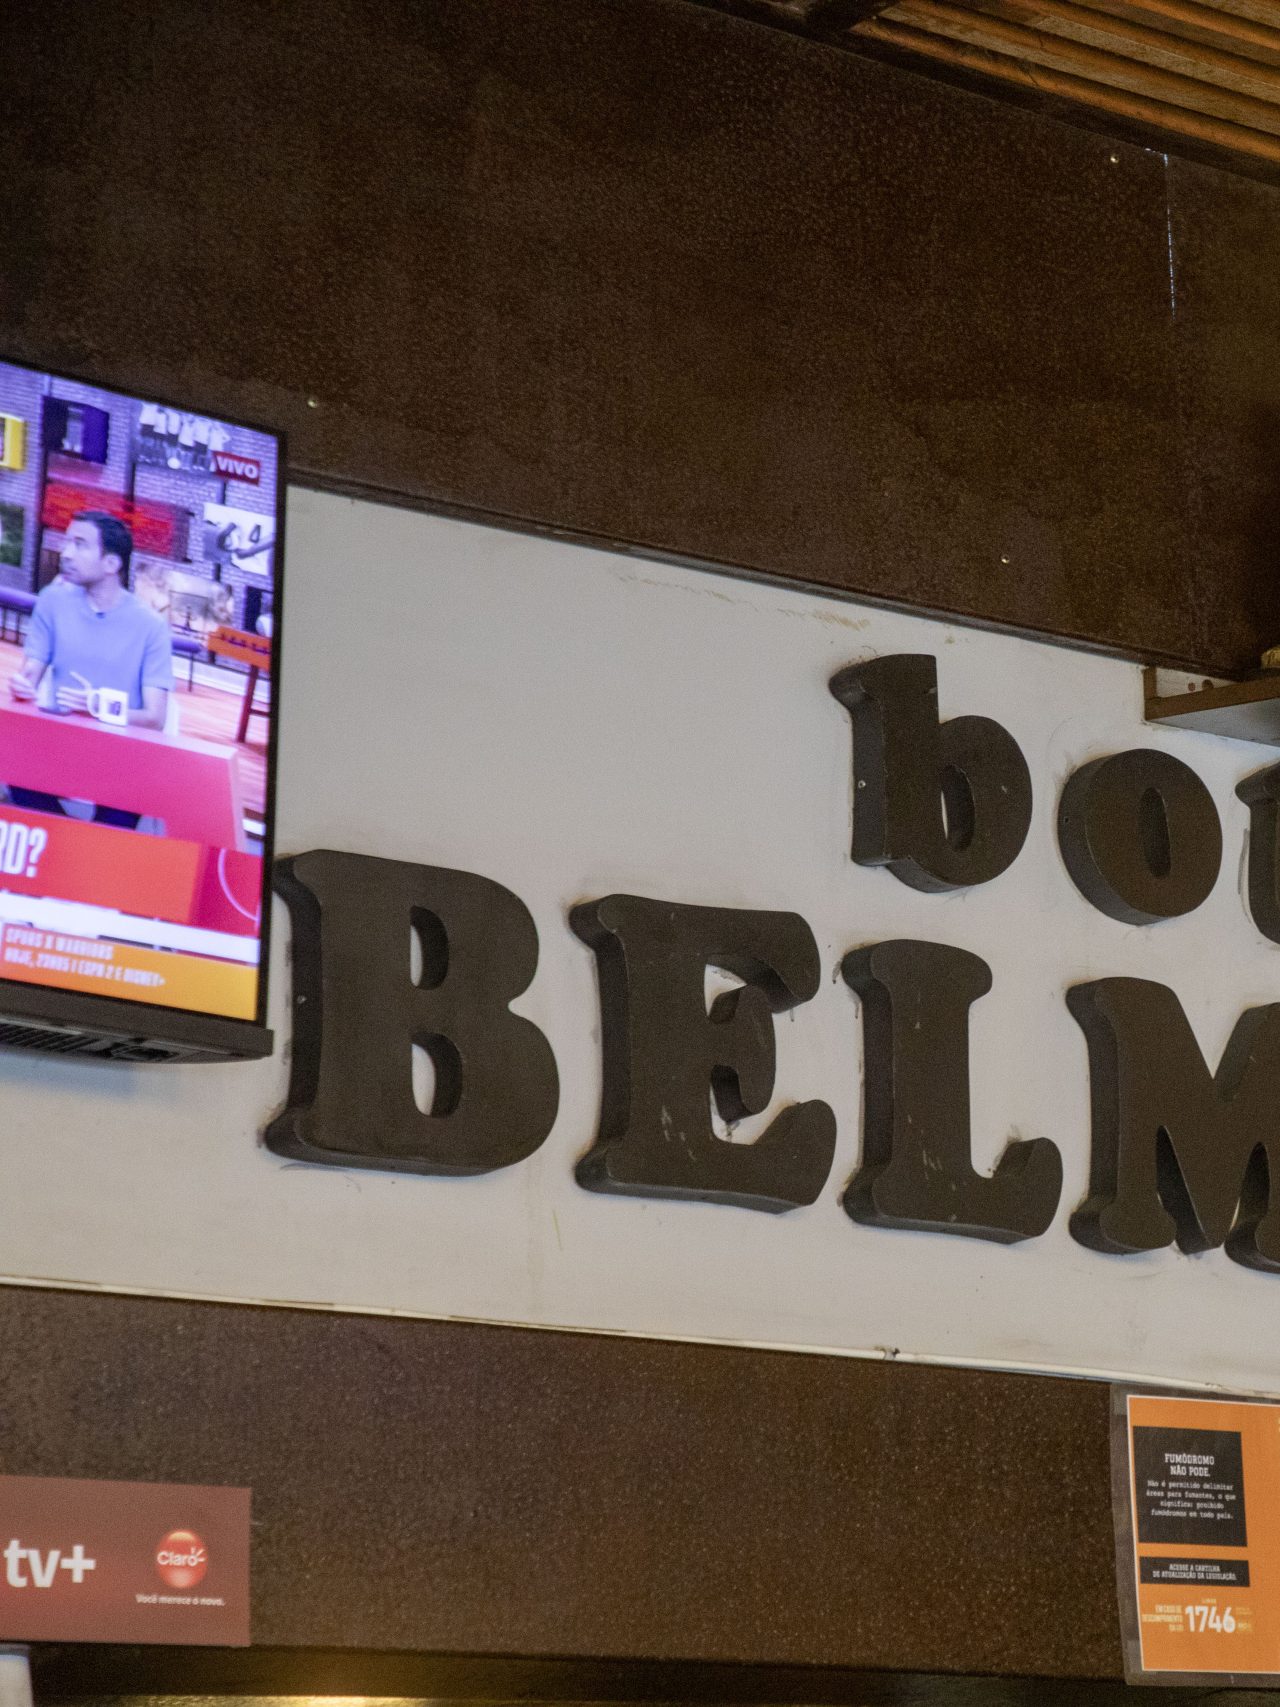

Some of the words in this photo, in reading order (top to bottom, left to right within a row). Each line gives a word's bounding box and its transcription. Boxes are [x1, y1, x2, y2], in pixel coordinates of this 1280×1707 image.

[215, 455, 258, 479] VIVO
[1170, 1465, 1187, 1475] NÃO
[1189, 1466, 1211, 1477] PODE.
[4, 1539, 96, 1588] tv+
[157, 1550, 199, 1567] Claro
[1185, 1605, 1236, 1633] 1746
